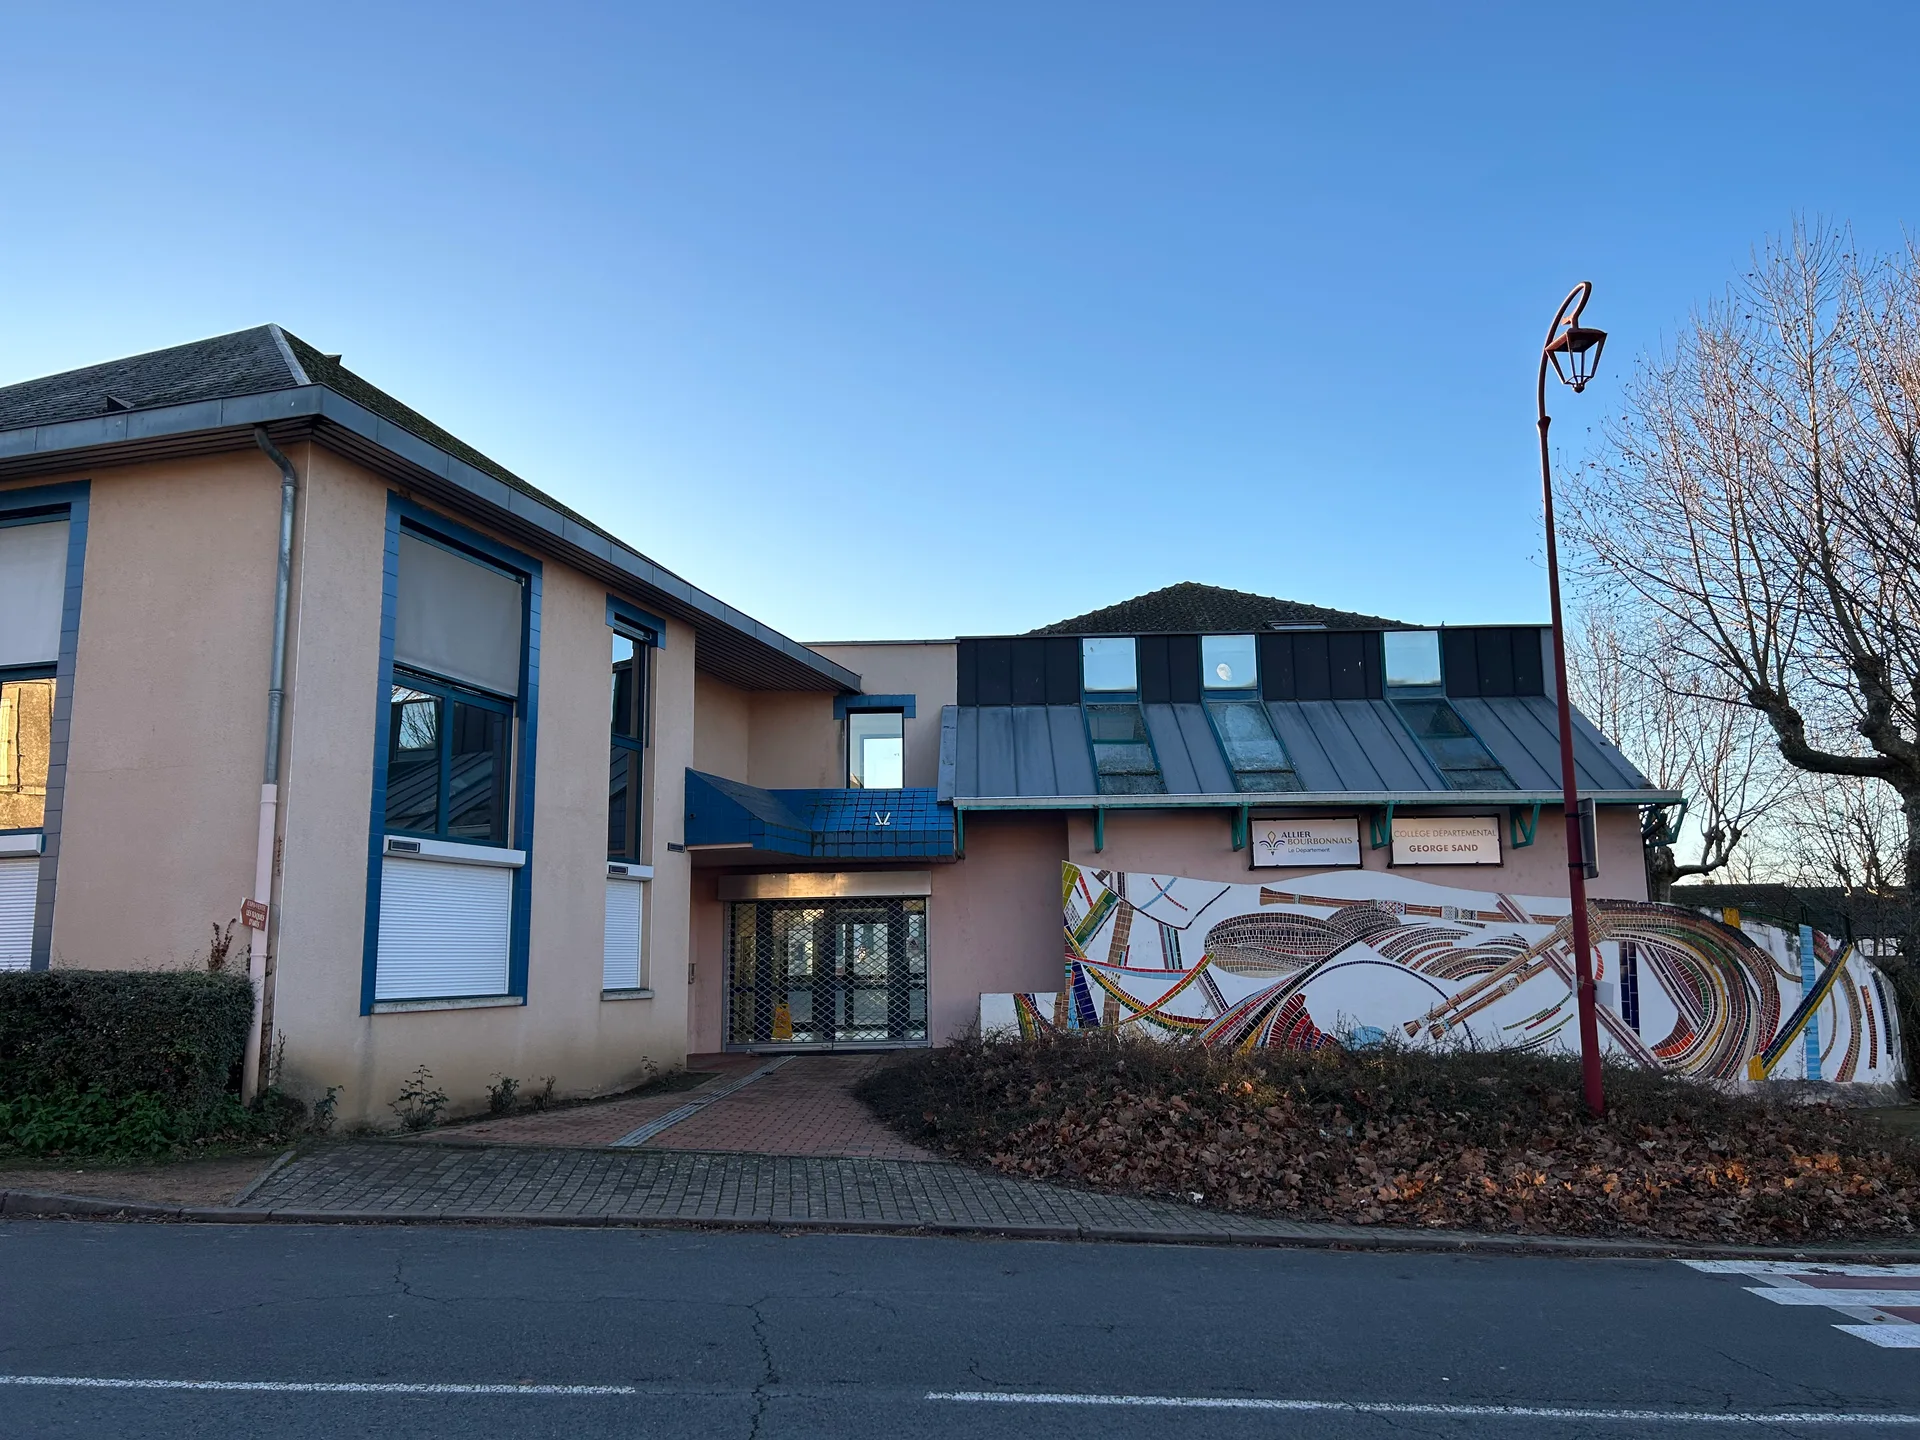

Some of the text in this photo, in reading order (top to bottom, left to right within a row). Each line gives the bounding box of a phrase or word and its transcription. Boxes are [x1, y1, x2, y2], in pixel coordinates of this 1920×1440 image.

[1281, 831, 1311, 839] ALLIER
[1432, 828, 1497, 838] DÉPARTEMENTAL
[1287, 837, 1353, 846] BOURBONNAIS
[1409, 844, 1479, 853] GEORGE SAND
